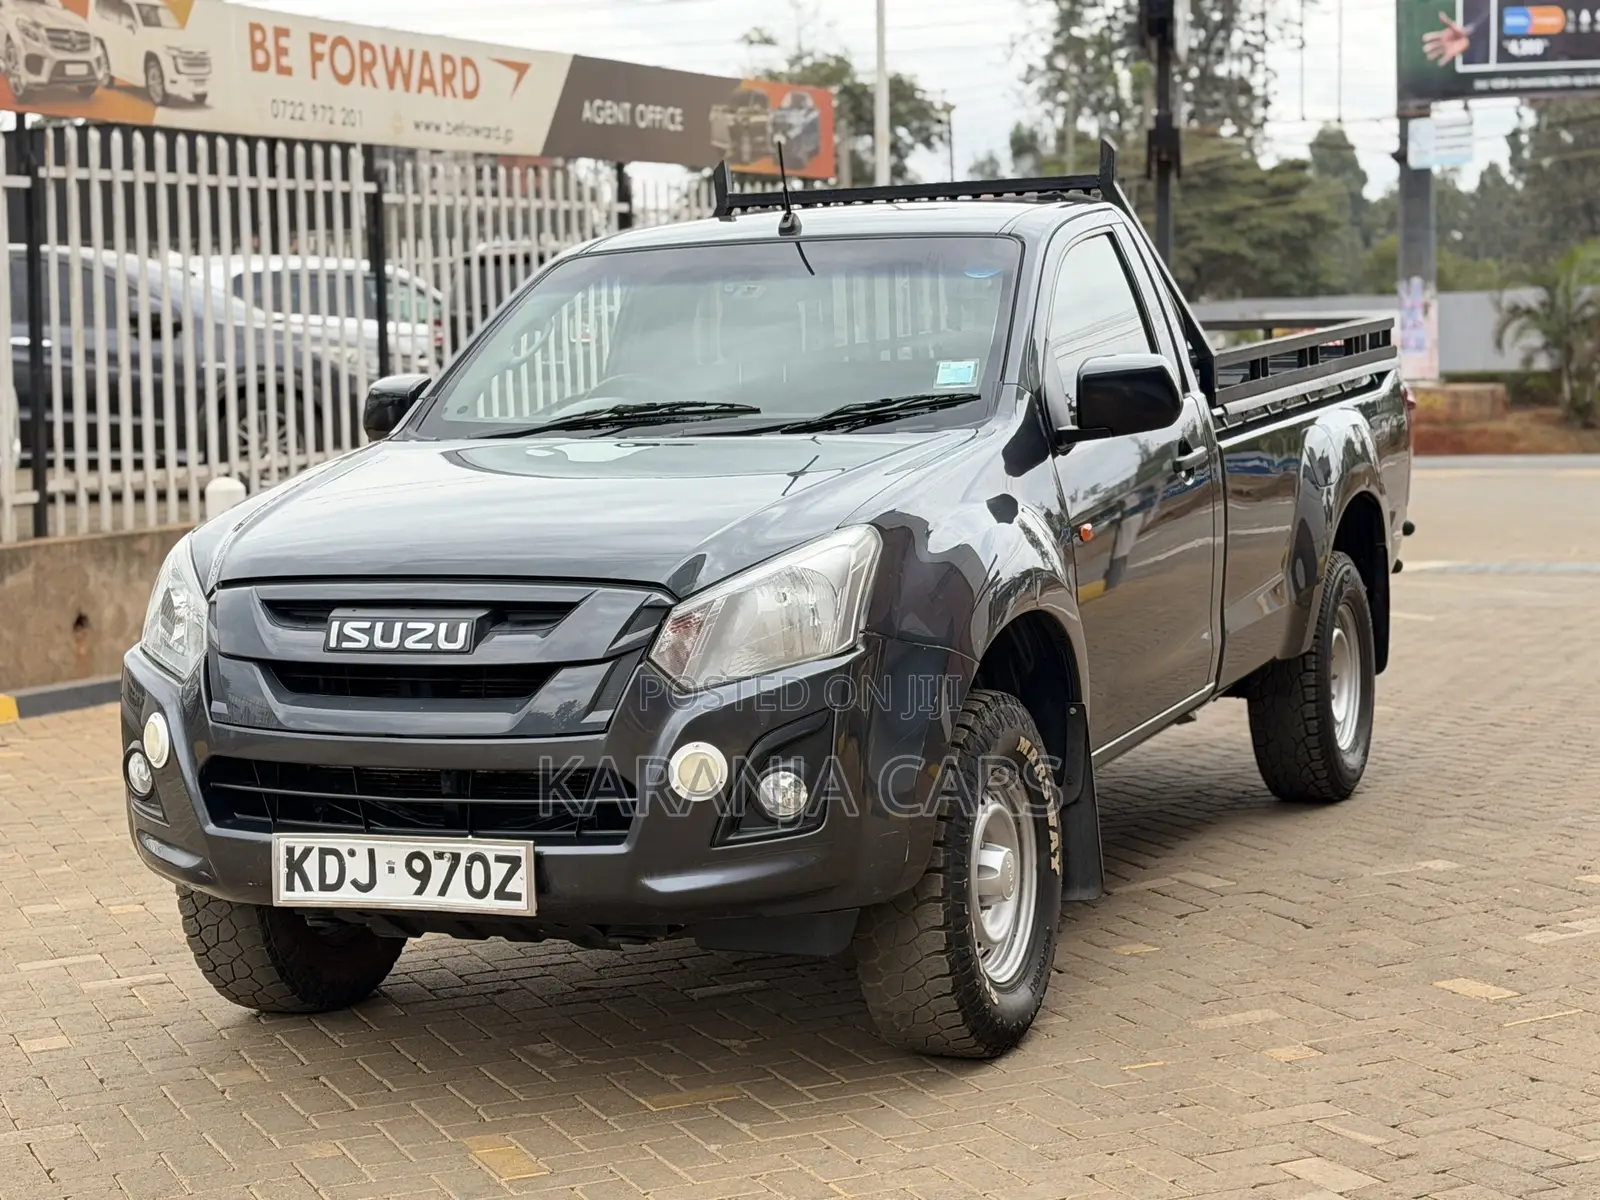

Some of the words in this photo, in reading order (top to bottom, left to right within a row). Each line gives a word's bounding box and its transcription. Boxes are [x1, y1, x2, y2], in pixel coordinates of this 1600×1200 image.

[249, 22, 293, 77] BE
[309, 31, 480, 100] FORWARD
[270, 98, 306, 121] 0722
[581, 98, 631, 126] AGENT
[634, 103, 685, 132] OFFICE
[328, 620, 469, 651] ISUZU
[284, 844, 378, 894] KDJ
[404, 850, 523, 902] 970Z
